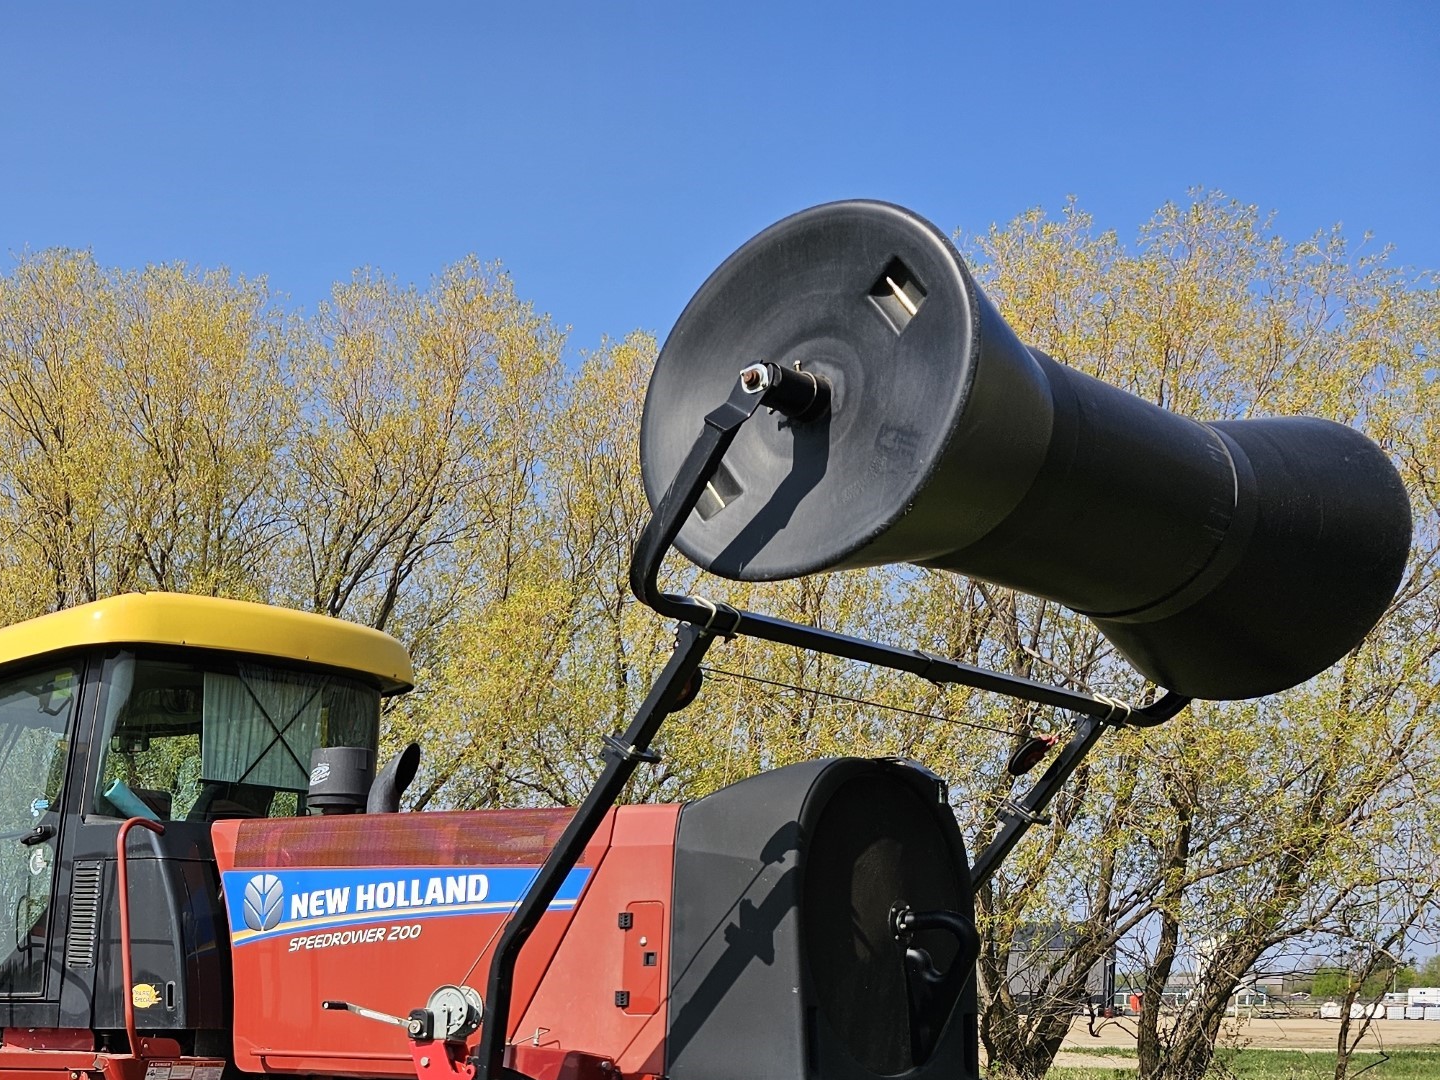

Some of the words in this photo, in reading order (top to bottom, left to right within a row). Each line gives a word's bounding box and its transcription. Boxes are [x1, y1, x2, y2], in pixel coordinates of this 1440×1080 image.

[291, 886, 350, 920] NEW
[356, 874, 489, 912] HOLLAND
[288, 927, 387, 952] SPEEDROWER
[387, 924, 422, 942] 200
